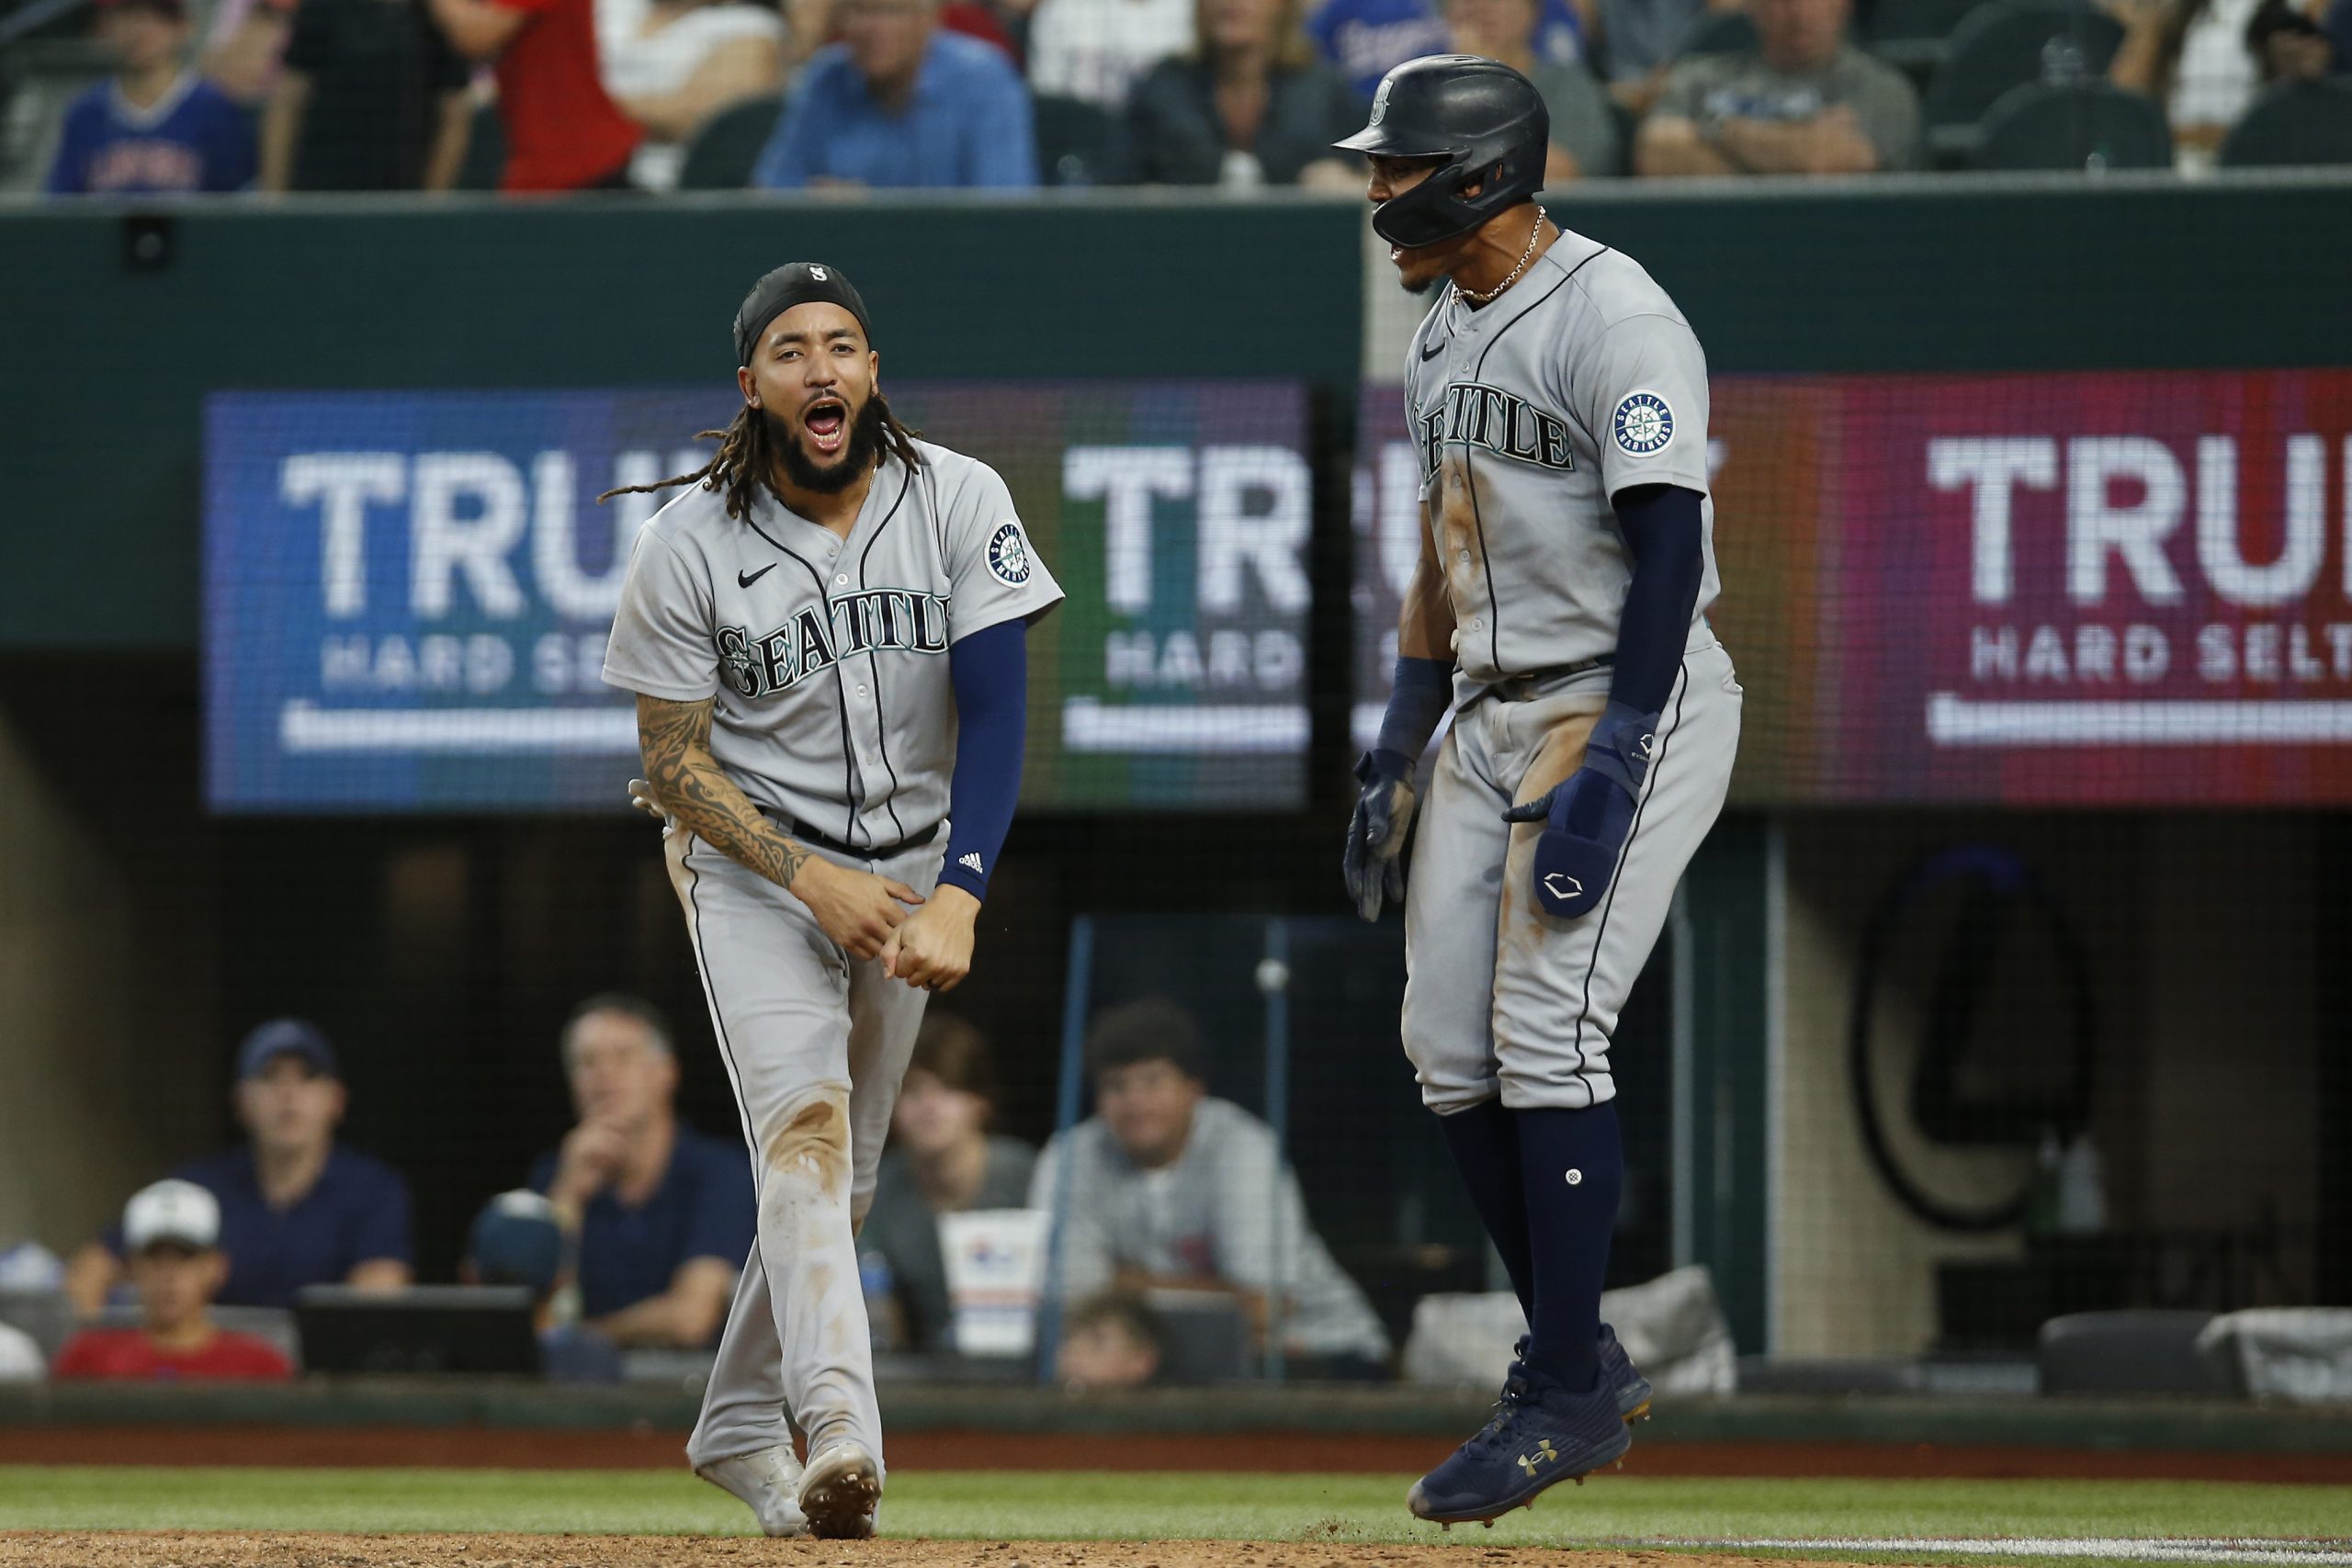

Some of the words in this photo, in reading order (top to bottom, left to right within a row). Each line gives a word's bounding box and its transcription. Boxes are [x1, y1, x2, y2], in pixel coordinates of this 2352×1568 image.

[1617, 396, 1668, 421] SEATTLE
[1618, 426, 1671, 451] MARINERS
[283, 451, 715, 618] TRU
[1928, 434, 2352, 606] TRU
[322, 635, 515, 693] HARD
[716, 587, 951, 700] SEATTL
[1107, 629, 1306, 690] HARD
[1970, 625, 2171, 682] HARD
